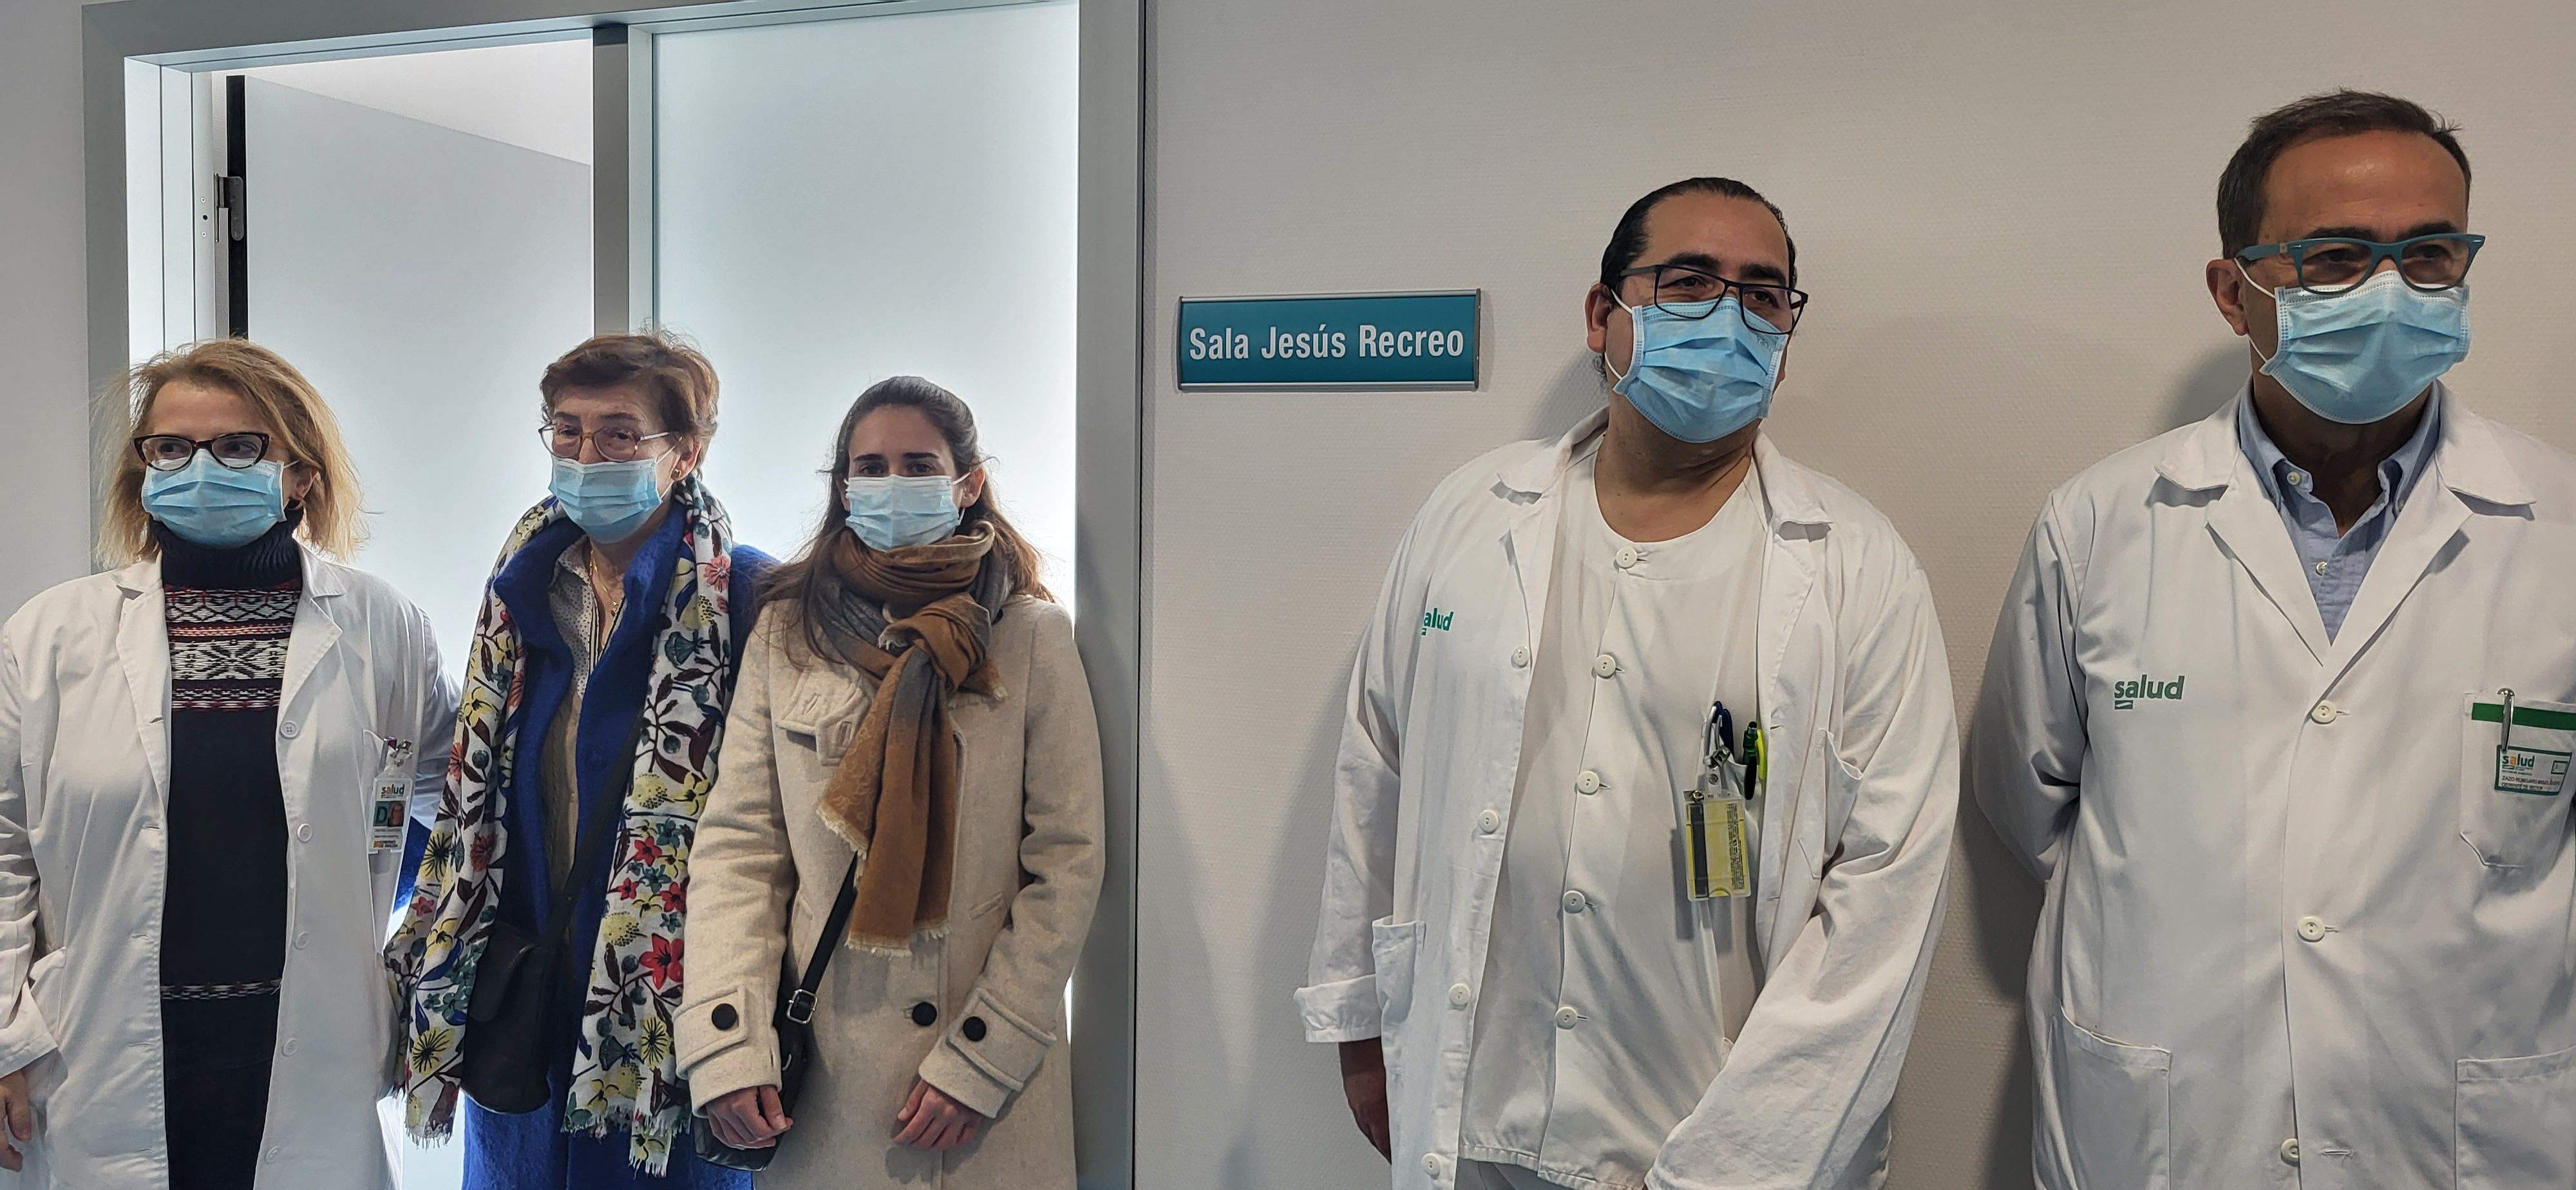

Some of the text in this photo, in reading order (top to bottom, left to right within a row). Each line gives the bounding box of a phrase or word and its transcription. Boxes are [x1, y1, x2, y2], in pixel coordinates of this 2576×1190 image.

[1189, 324, 1464, 361] Sala Jesús Recreo
[1424, 607, 1454, 631] alud
[2114, 674, 2185, 700] salud
[2502, 753, 2535, 768] salud
[381, 784, 405, 795] salud
